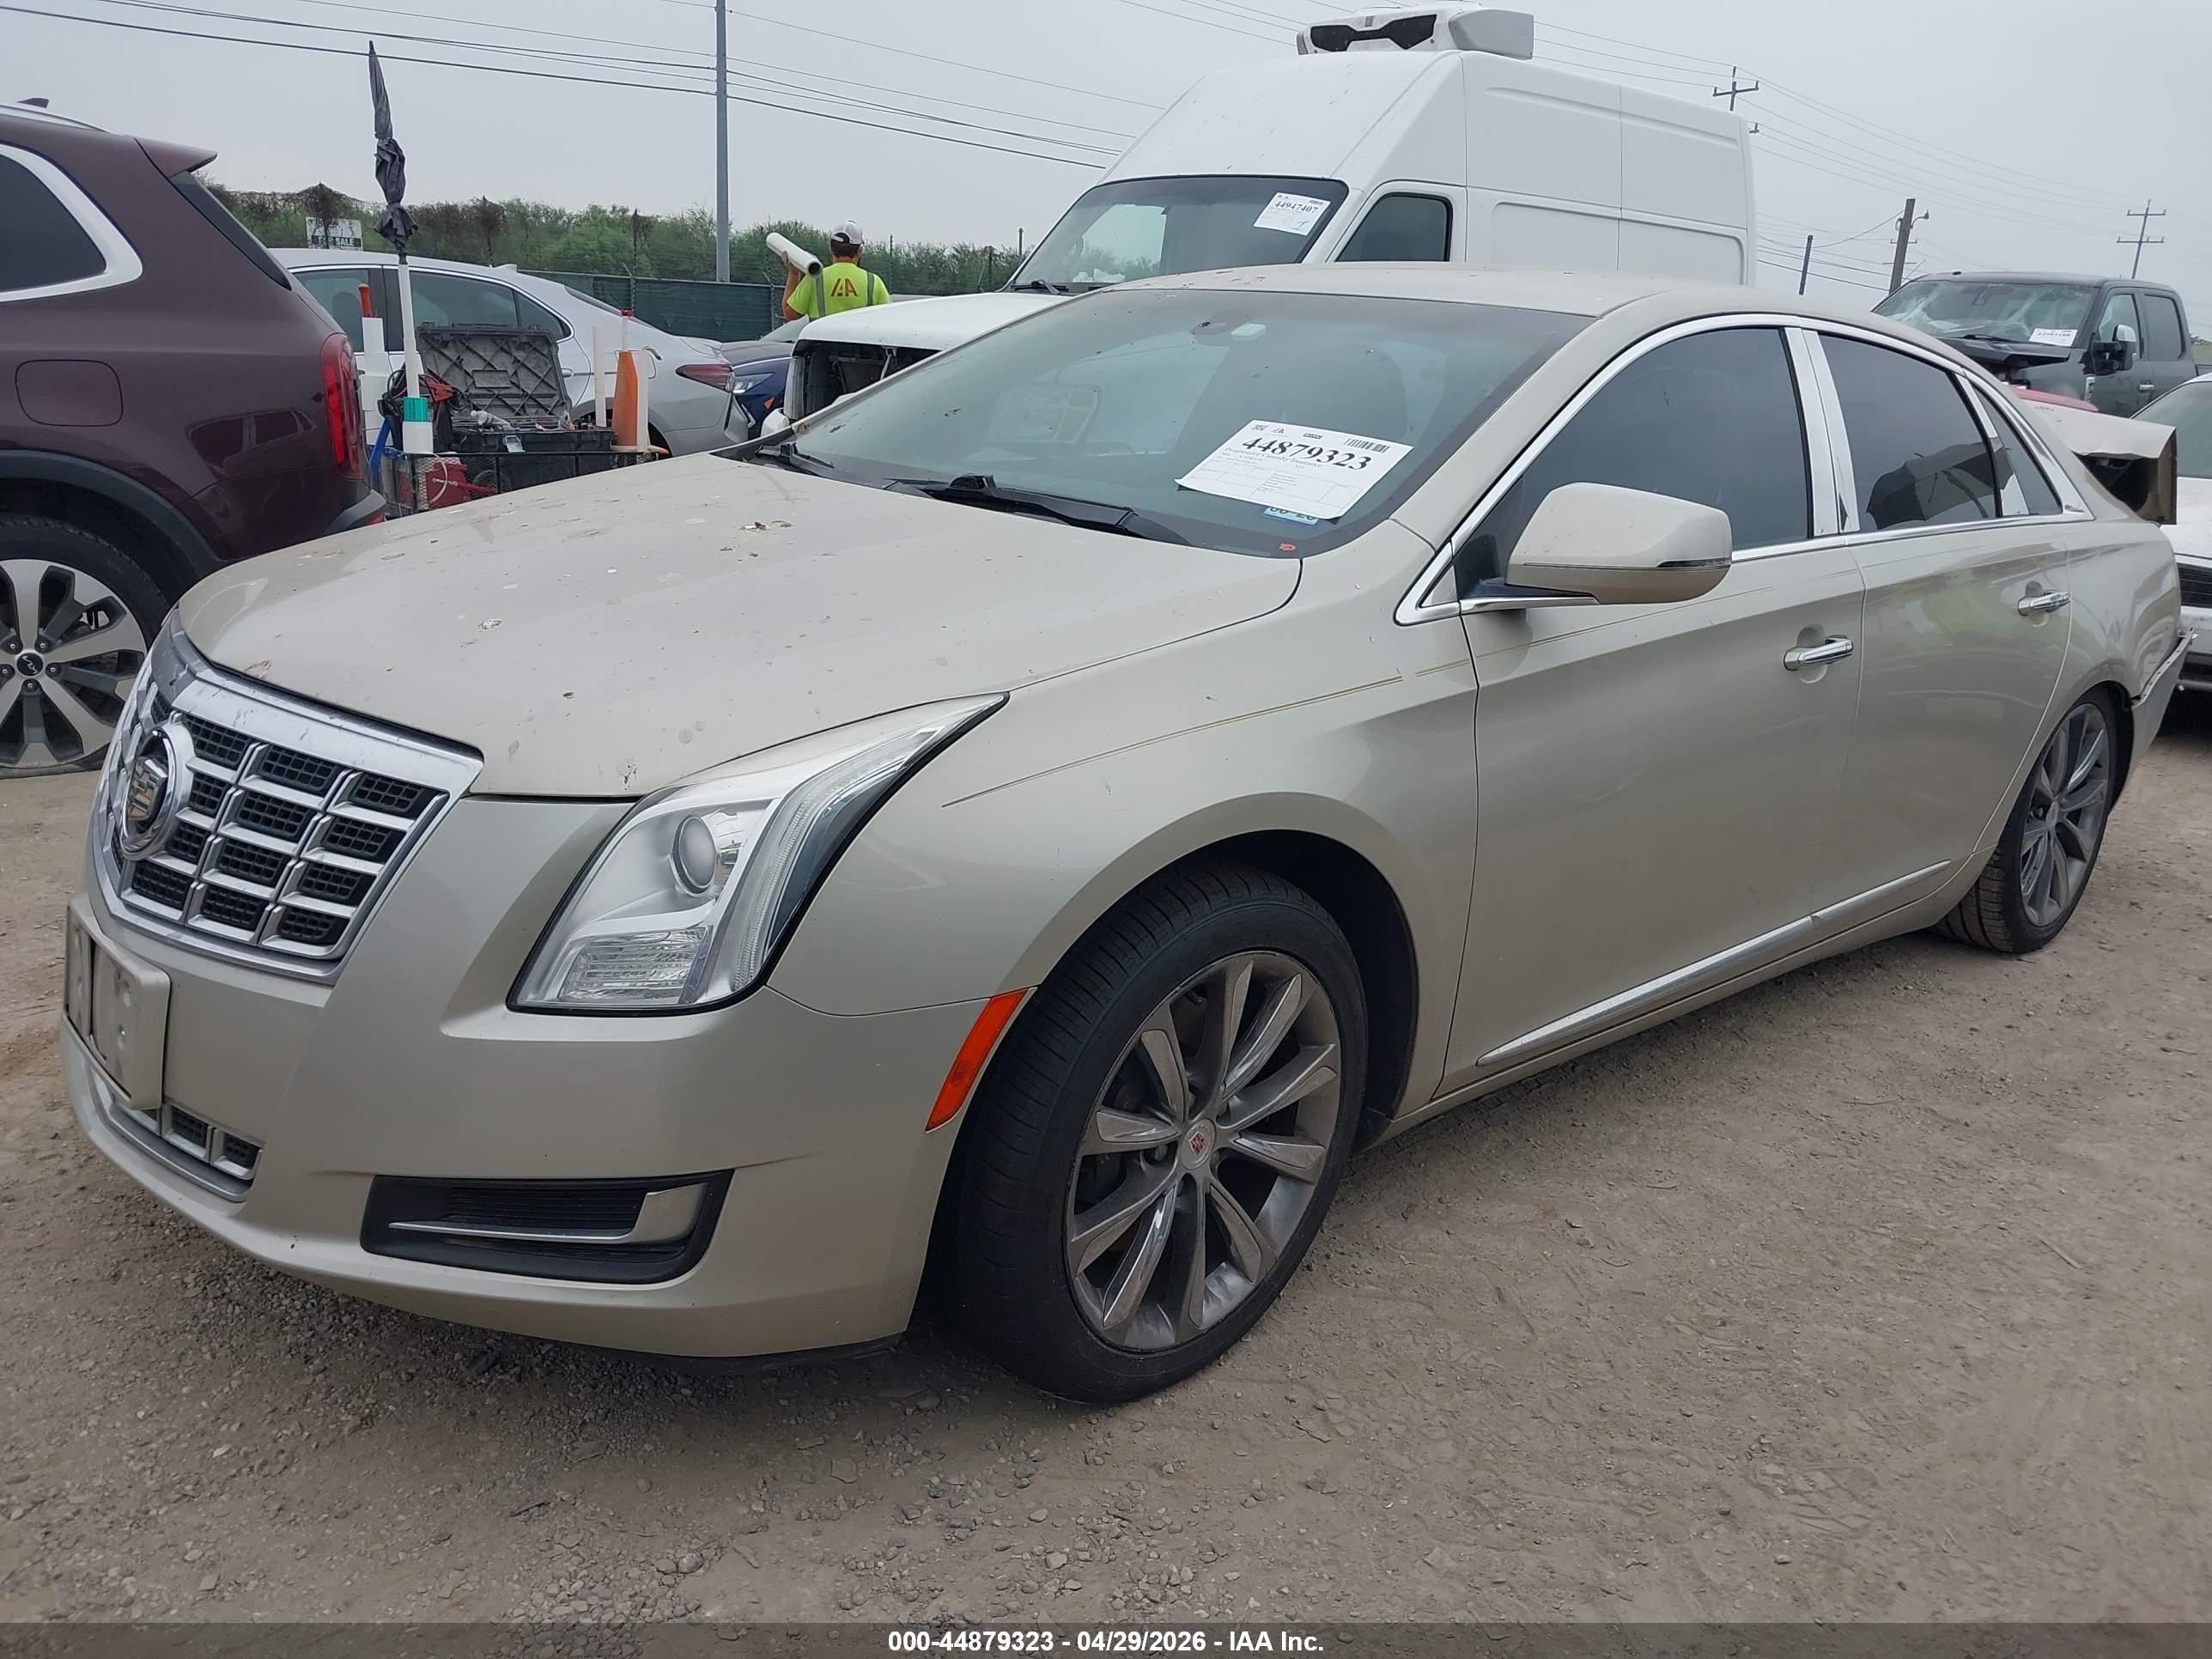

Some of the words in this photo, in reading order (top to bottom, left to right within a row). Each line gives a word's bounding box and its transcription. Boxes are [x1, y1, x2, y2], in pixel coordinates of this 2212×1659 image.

[1274, 201, 1319, 214] 44947407
[336, 238, 355, 246] SALE
[1242, 437, 1372, 471] 44879323
